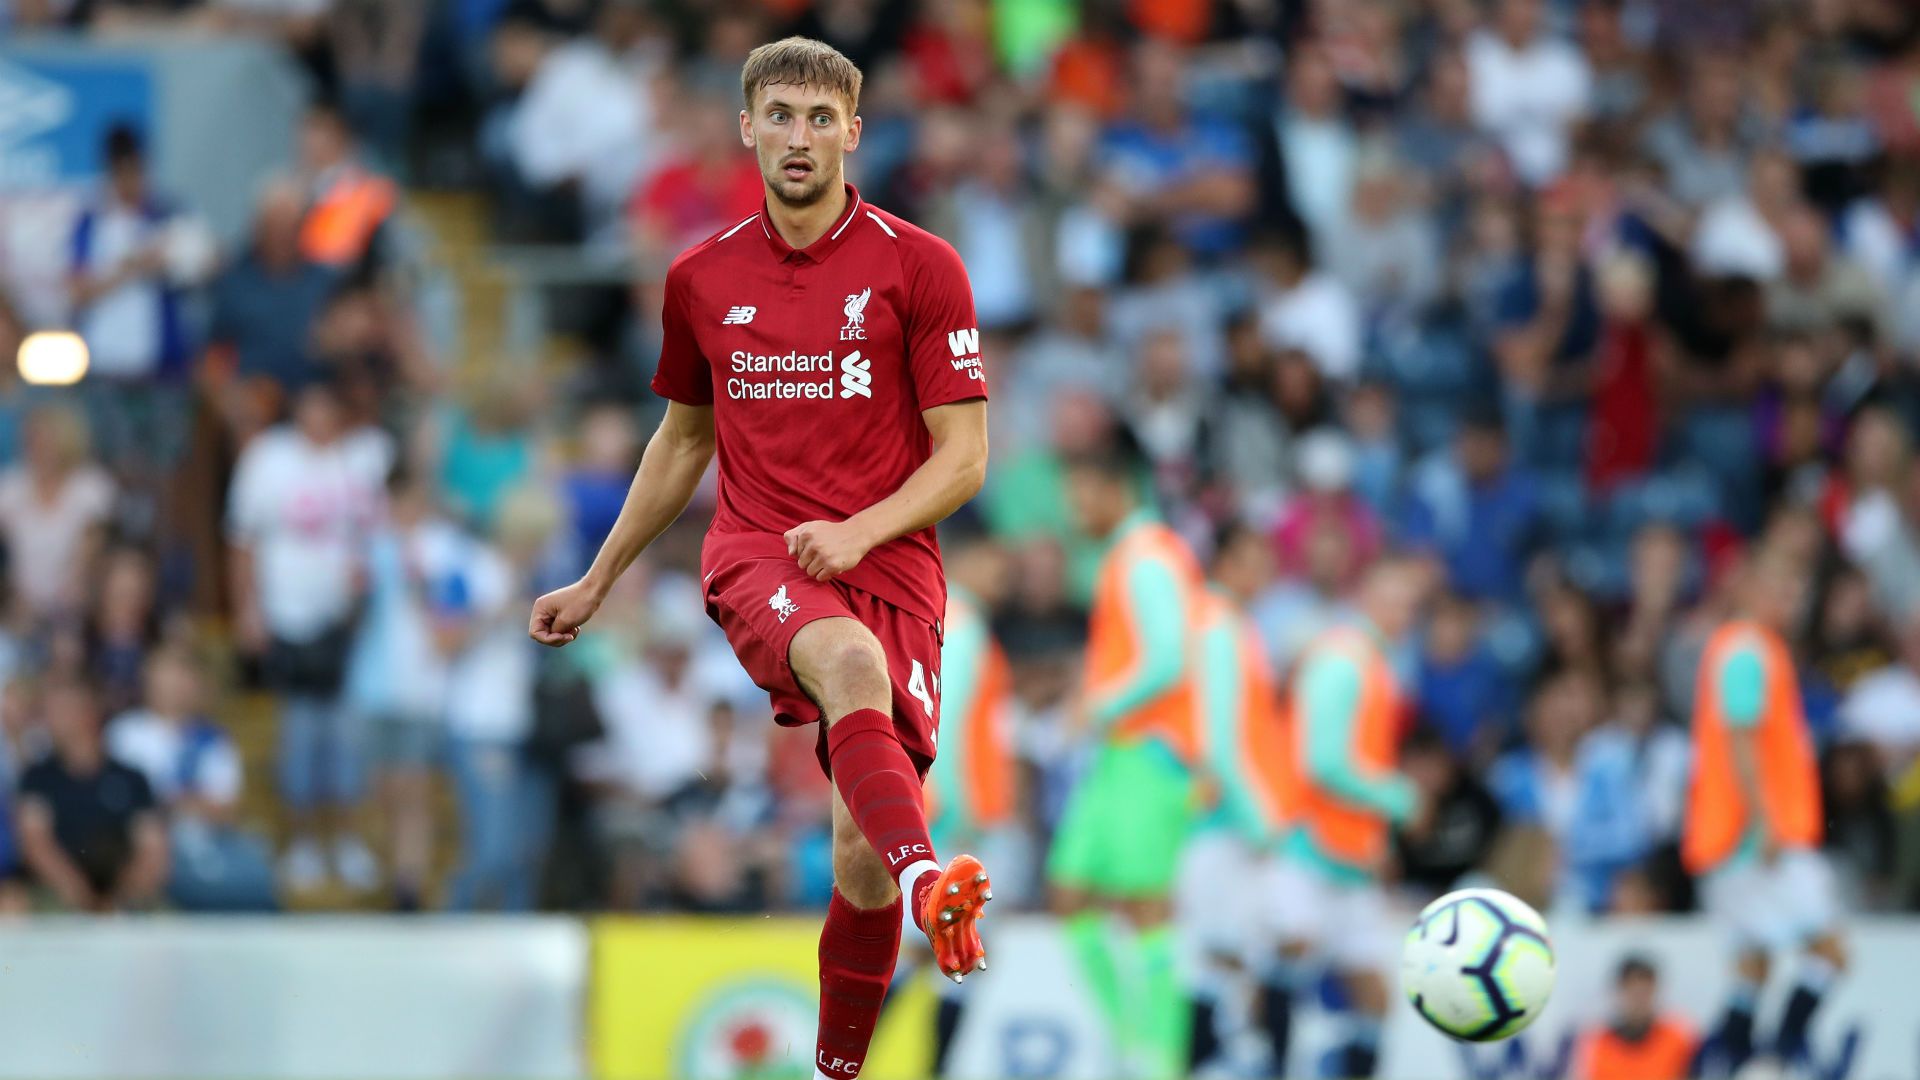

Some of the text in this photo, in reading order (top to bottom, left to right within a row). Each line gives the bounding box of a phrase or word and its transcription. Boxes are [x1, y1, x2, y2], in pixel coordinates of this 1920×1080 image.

[839, 329, 867, 341] L.F.C.
[731, 350, 833, 373] Standard
[727, 377, 834, 400] Chartered
[887, 843, 931, 866] L.F.C.
[819, 1049, 859, 1075] L.F.C.
